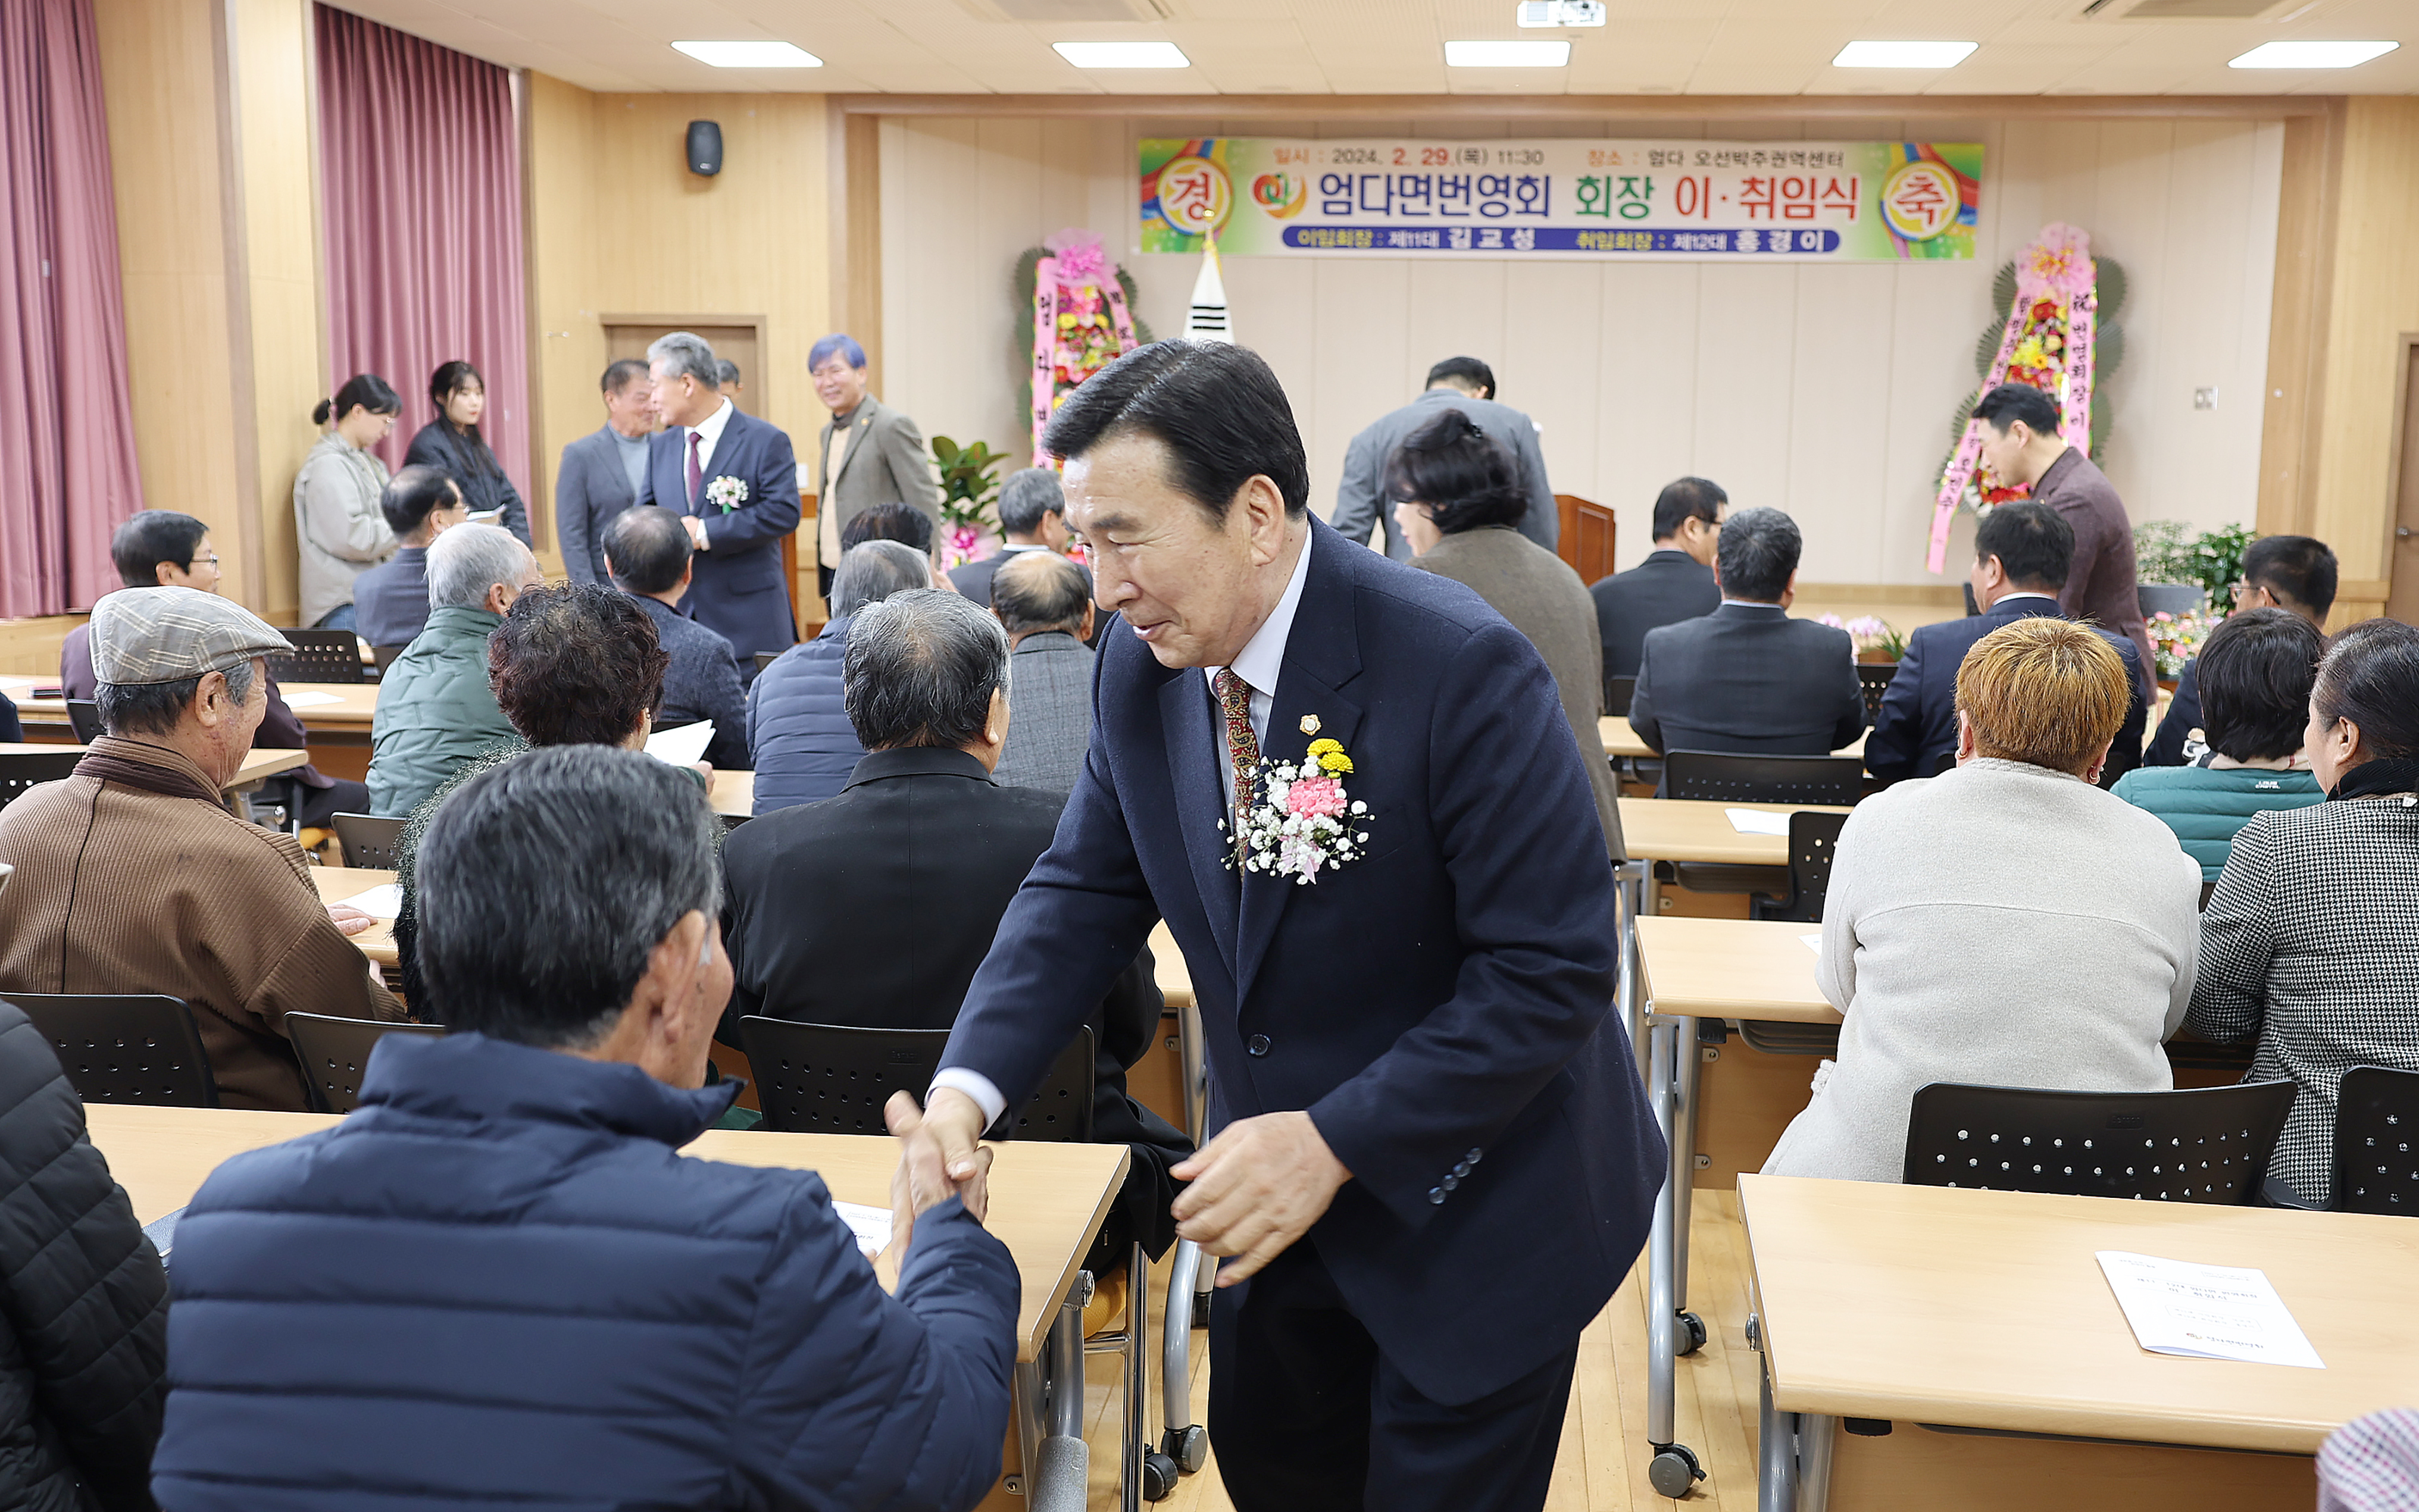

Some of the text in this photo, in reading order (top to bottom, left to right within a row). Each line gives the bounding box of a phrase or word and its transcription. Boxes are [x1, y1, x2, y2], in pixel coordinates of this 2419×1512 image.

[1273, 148, 1309, 165] 일시
[1332, 148, 1383, 165] 2024.
[1392, 148, 1411, 166] 2.
[1498, 150, 1545, 165] 11:30
[1587, 150, 1624, 168] 장소
[1648, 150, 1684, 168] 엄다
[1320, 173, 1549, 218] 엄다면번영회
[1576, 175, 1655, 219] 회장
[1897, 176, 1946, 226] 축
[1387, 230, 1439, 248] 제11대
[1672, 233, 1727, 251] 제12대
